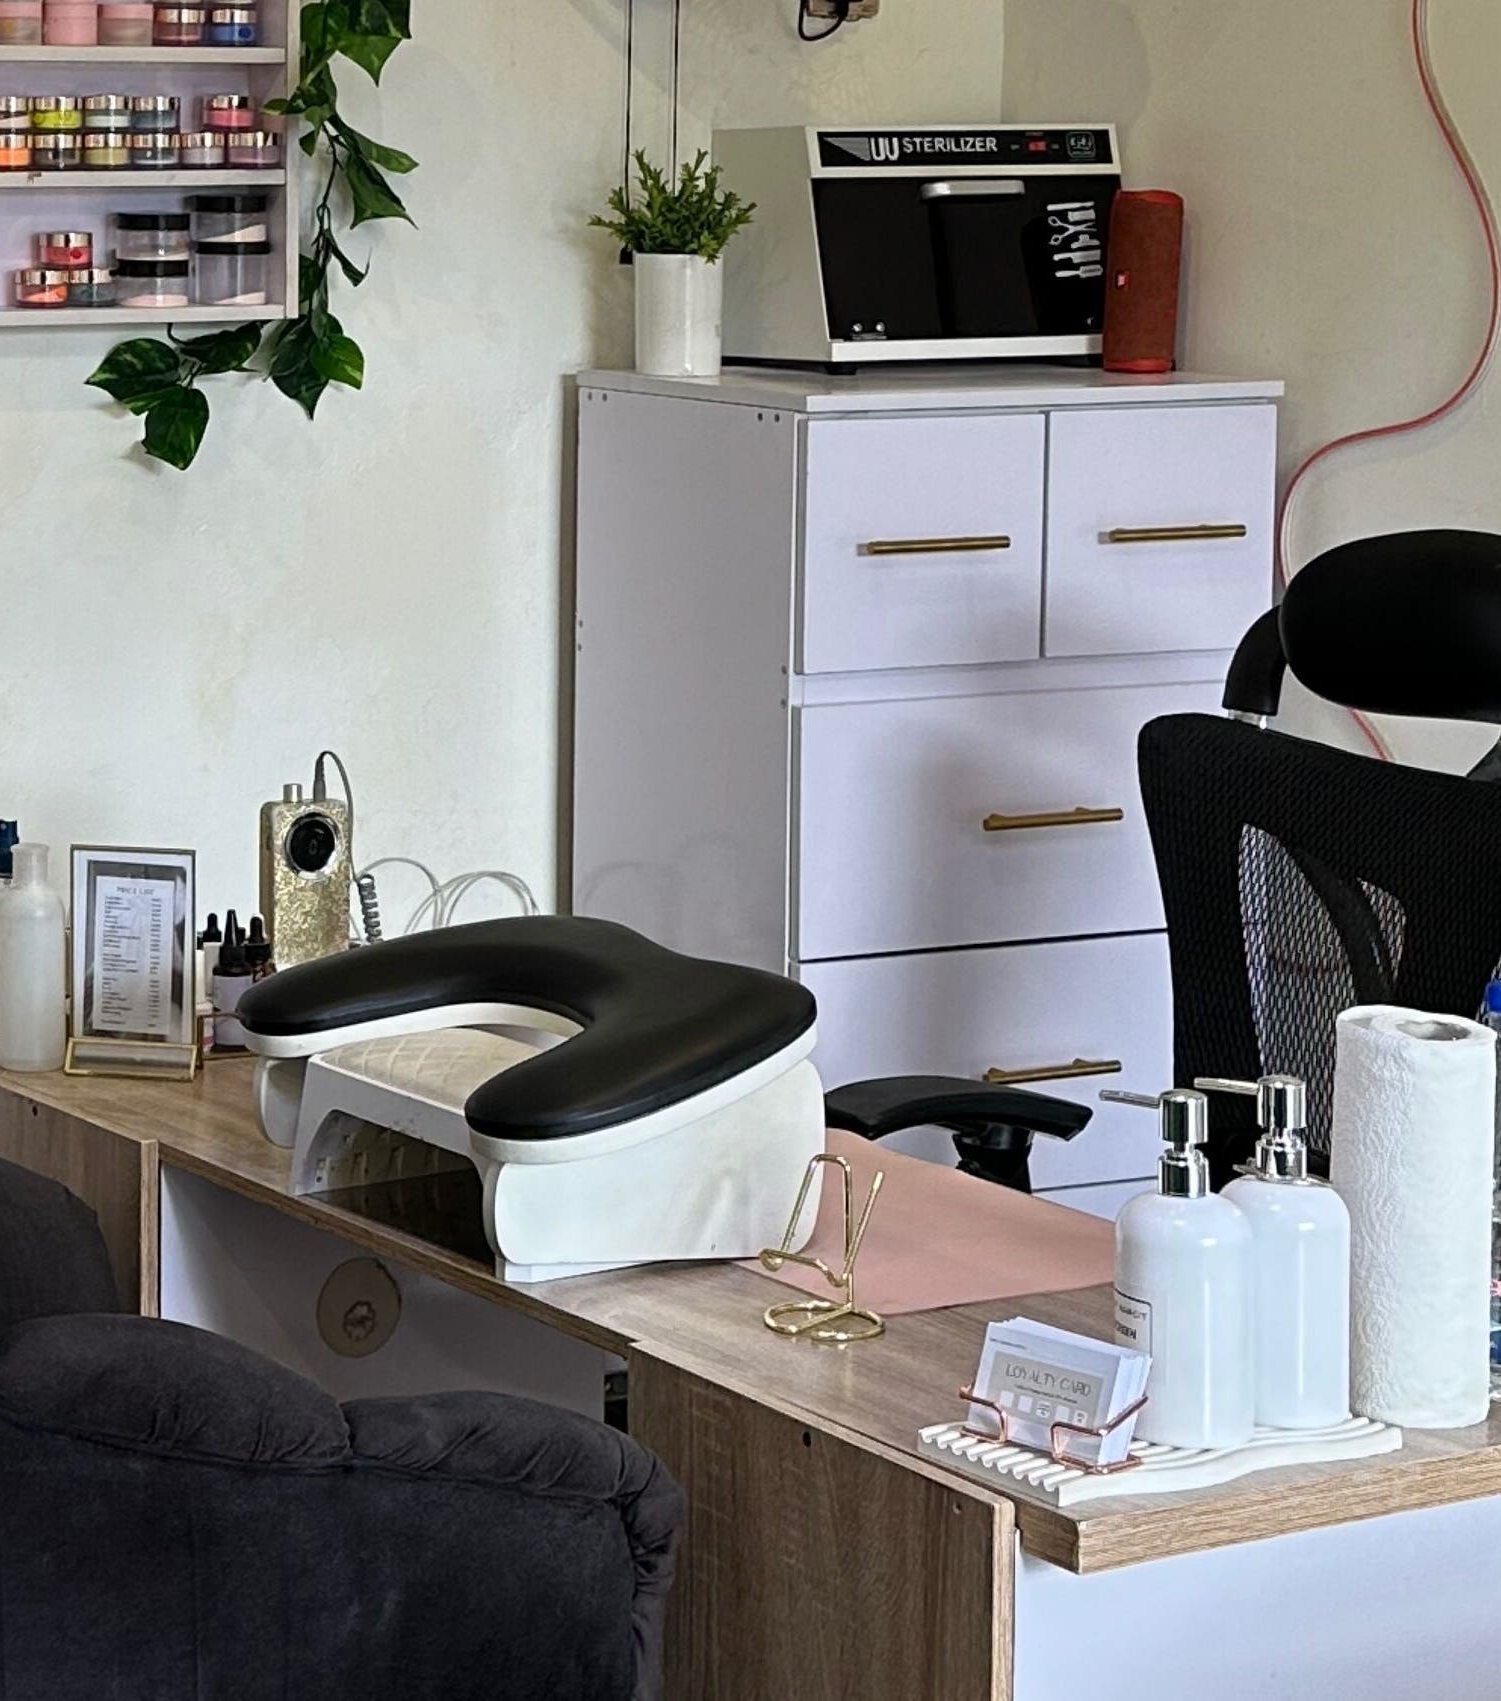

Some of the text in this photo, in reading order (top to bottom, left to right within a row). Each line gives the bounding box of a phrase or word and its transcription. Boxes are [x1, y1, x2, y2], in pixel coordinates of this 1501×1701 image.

[902, 136, 998, 153] STERILIZER
[1005, 1363, 1055, 1387] LOYALTY
[1060, 1377, 1092, 1398] CARD
